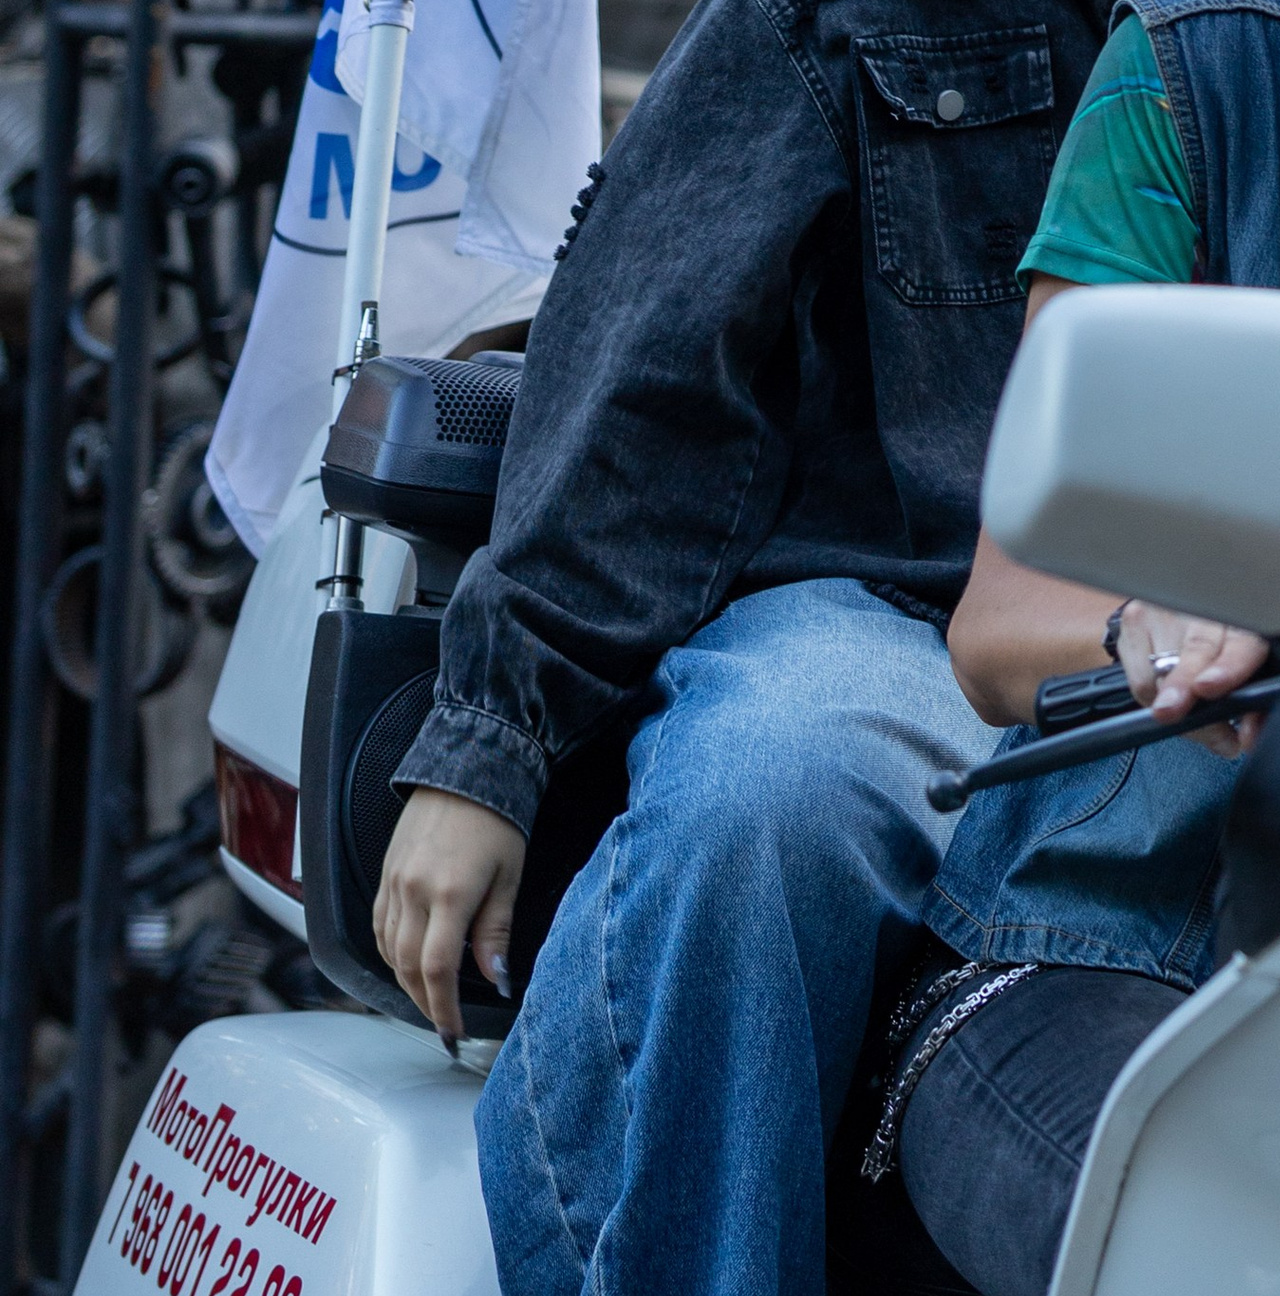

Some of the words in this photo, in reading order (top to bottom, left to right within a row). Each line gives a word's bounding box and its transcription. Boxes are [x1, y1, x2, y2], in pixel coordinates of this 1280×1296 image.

[108, 1160, 142, 1245] 7
[146, 1067, 338, 1246] МотоПрогулки
[120, 1174, 174, 1275] 968
